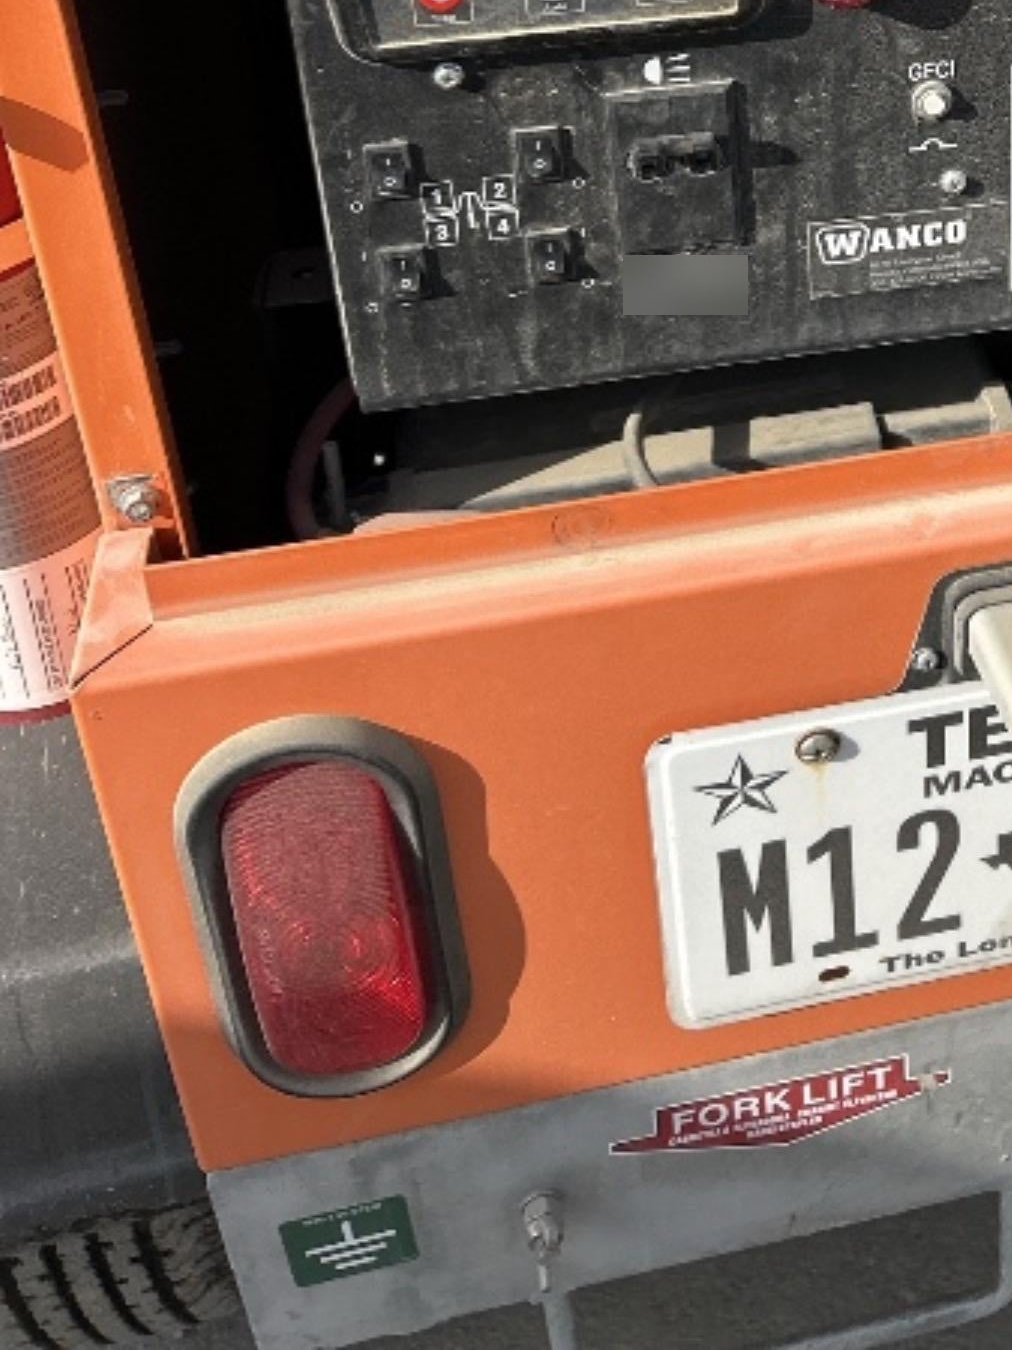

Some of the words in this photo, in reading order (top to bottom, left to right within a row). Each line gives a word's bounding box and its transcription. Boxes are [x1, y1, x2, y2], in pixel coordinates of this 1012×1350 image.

[908, 59, 957, 82] GFCI
[431, 189, 442, 205] 1
[493, 182, 506, 199] 2
[436, 224, 449, 241] 3
[498, 217, 510, 235] 4
[824, 218, 967, 258] WANCO
[716, 808, 962, 977] M12
[878, 950, 946, 975] The
[671, 1085, 791, 1136] FORK
[802, 1065, 893, 1107] LIFT
